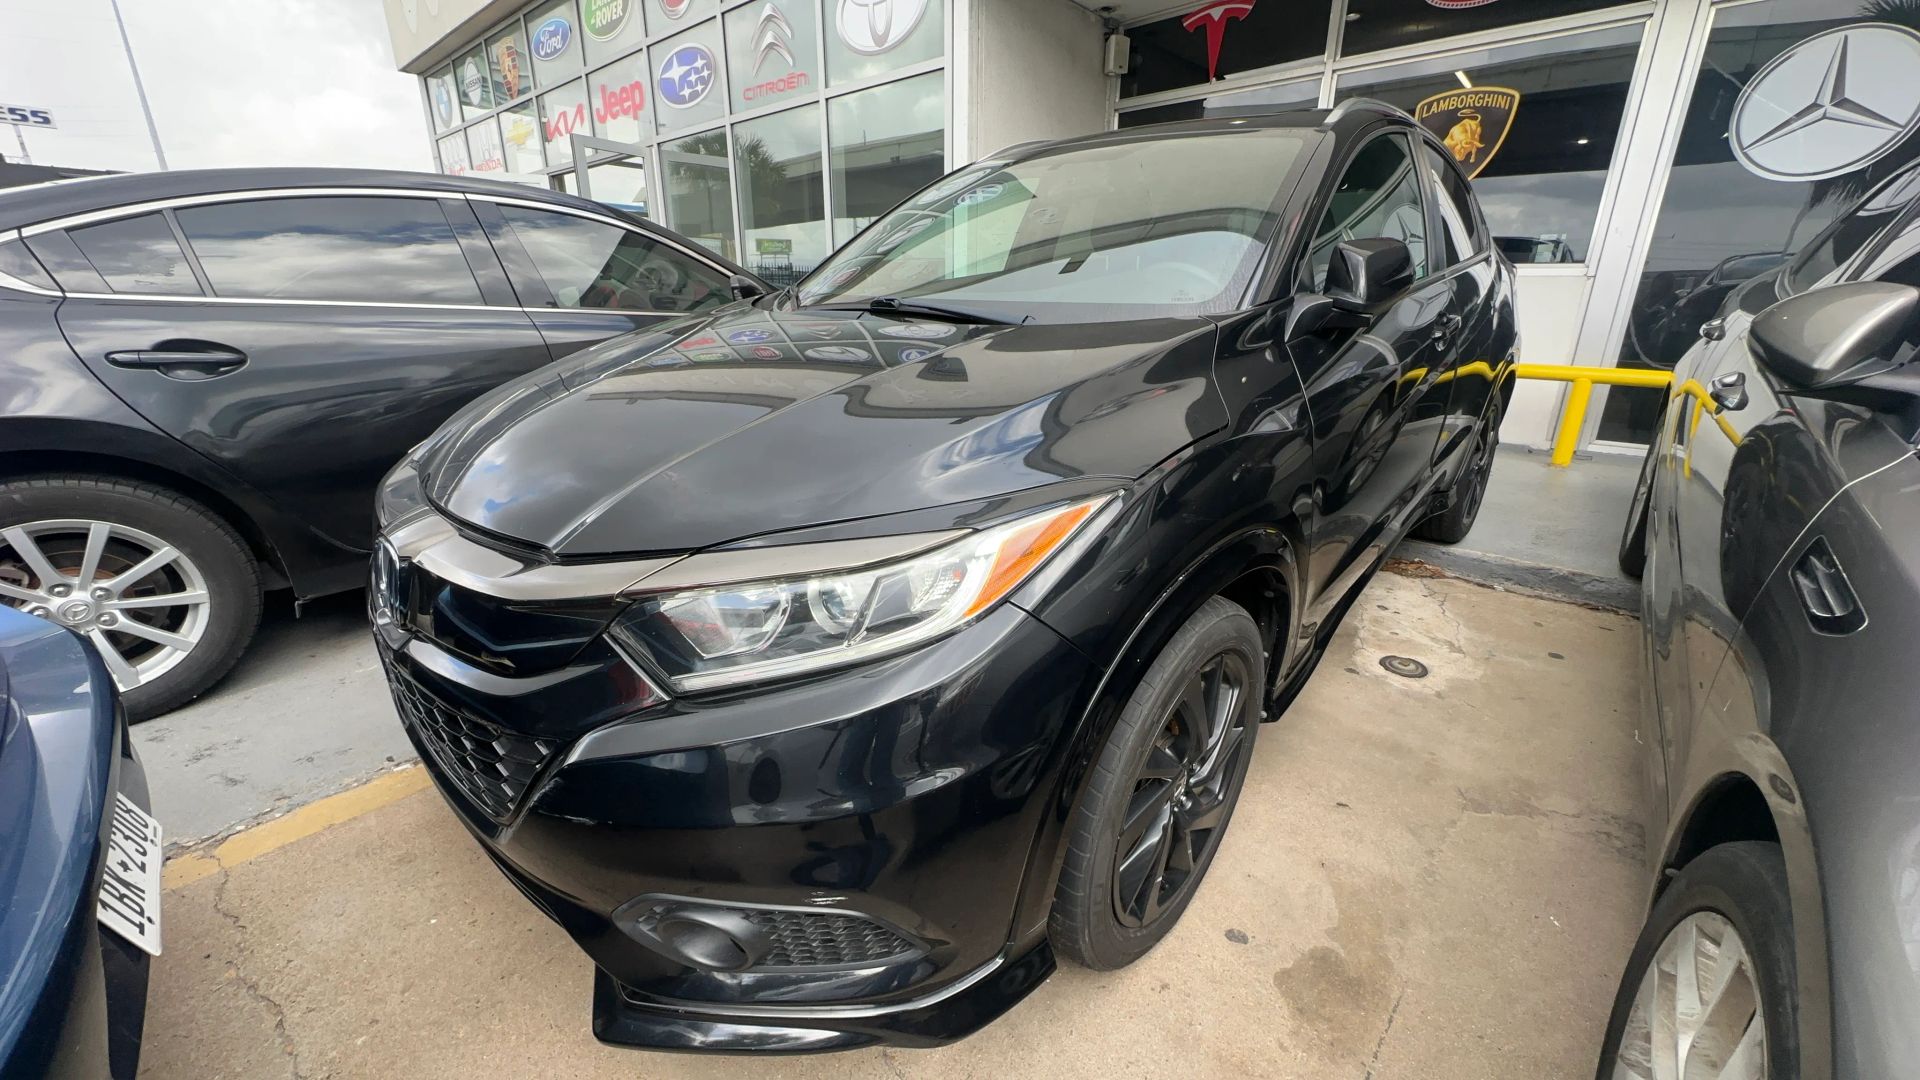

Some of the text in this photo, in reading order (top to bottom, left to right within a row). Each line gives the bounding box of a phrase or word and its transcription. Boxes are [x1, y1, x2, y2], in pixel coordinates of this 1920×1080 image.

[596, 0, 623, 29] ROVER
[539, 25, 563, 55] Ford
[595, 80, 644, 124] Jeep
[1422, 93, 1511, 118] LAMBORGHINI
